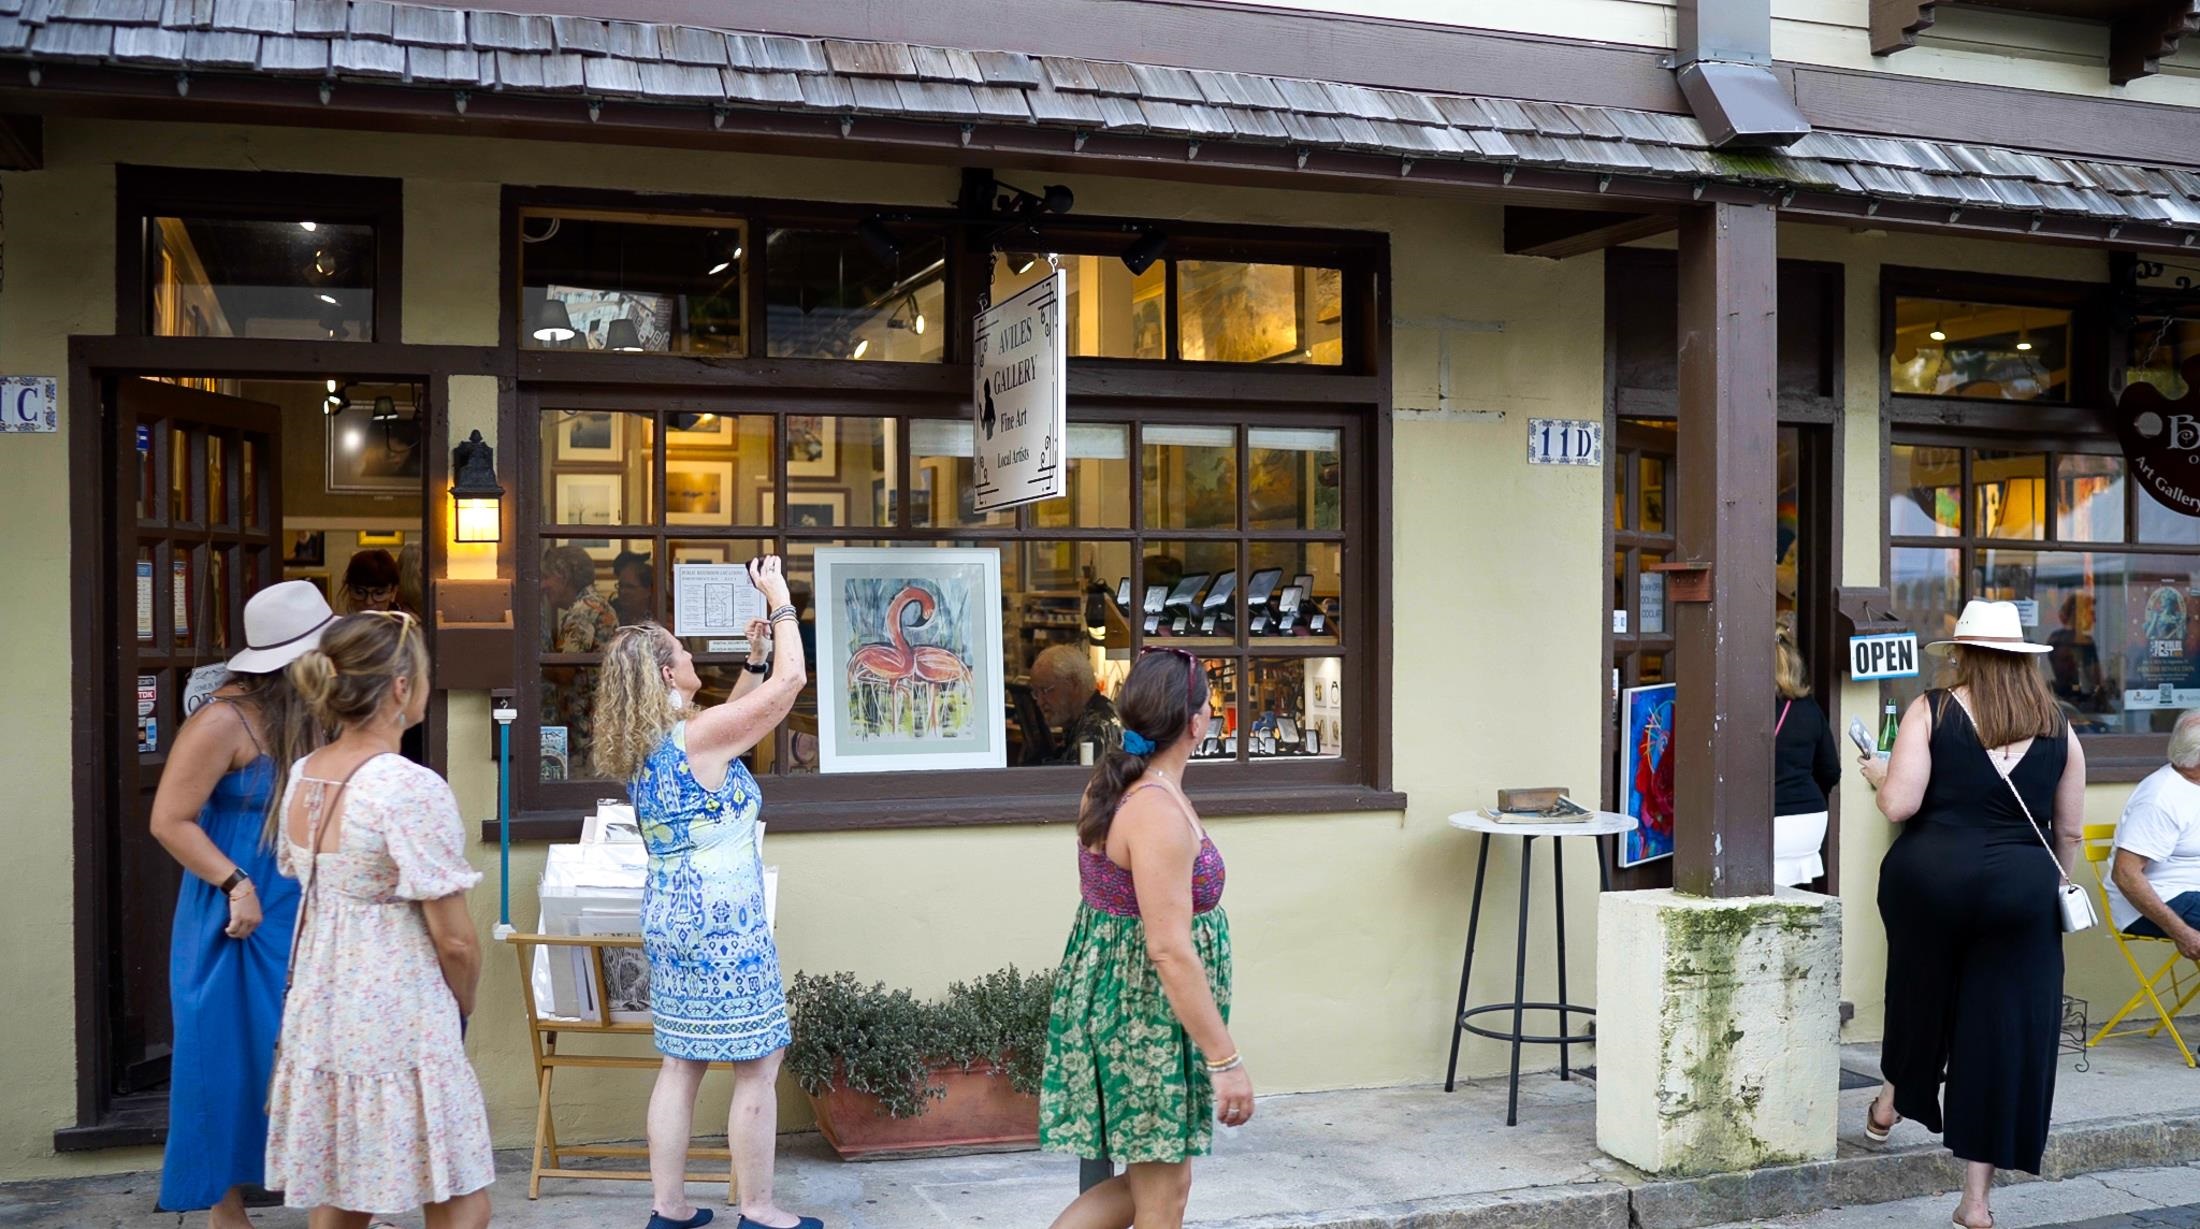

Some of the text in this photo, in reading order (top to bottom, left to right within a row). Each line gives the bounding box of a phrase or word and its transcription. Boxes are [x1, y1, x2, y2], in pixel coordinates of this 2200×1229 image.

[999, 316, 1032, 355] AVILES
[994, 354, 1038, 395] GALLERY
[1001, 407, 1027, 433] Fine Art
[998, 446, 1030, 469] Local Artists
[1541, 427, 1592, 457] 11D
[2135, 455, 2200, 513] Art Gallery
[1855, 639, 1914, 675] OPEN
